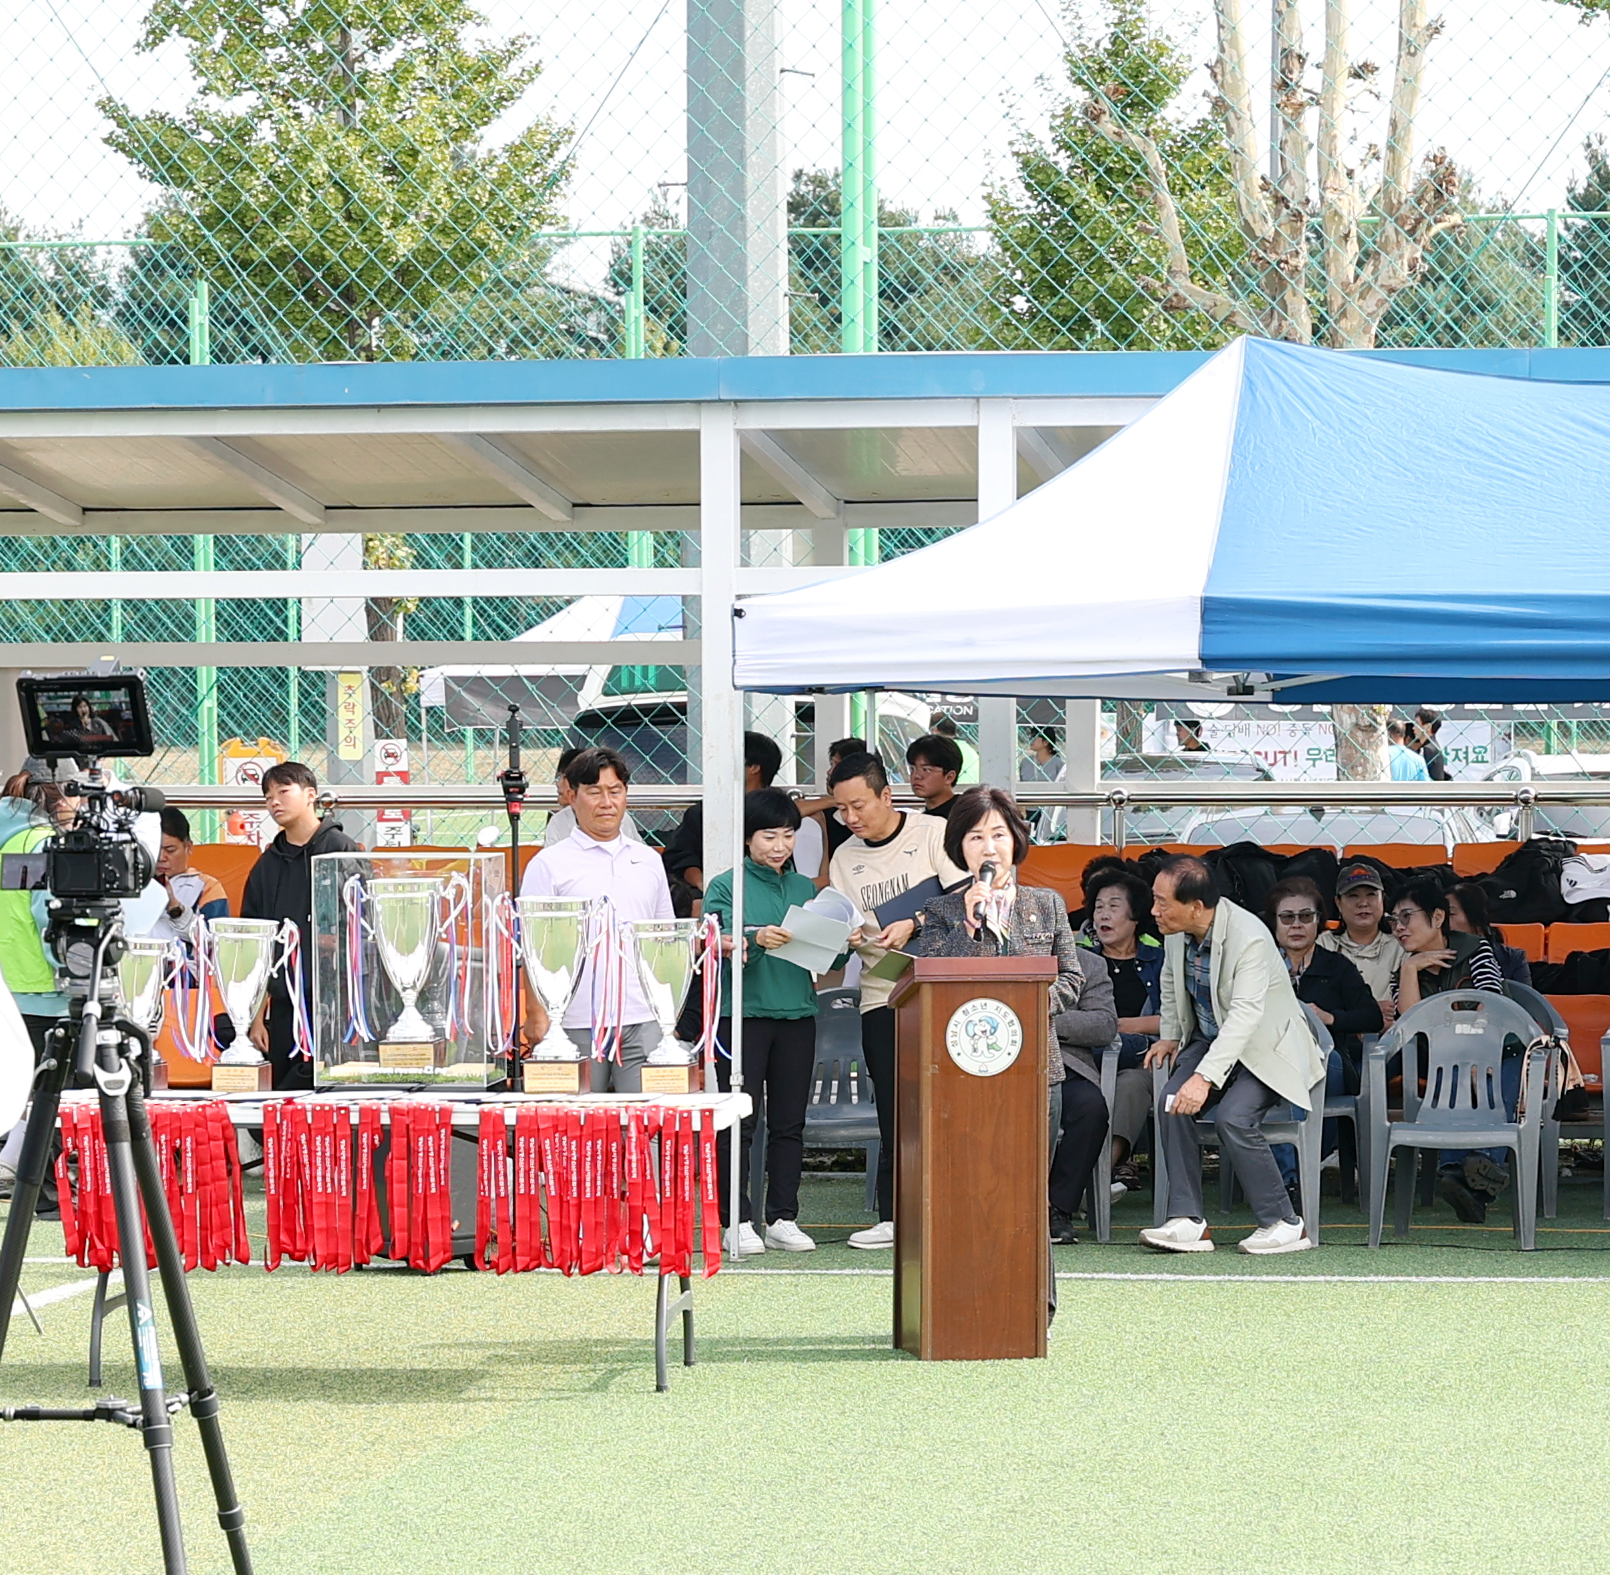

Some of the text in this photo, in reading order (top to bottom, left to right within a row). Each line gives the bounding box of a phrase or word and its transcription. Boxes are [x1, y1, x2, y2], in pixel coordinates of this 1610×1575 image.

[343, 684, 357, 750] 추락주의
[860, 873, 910, 912] SEONGNAM
[950, 1020, 961, 1048] 성남시
[962, 1002, 988, 1017] 청소년
